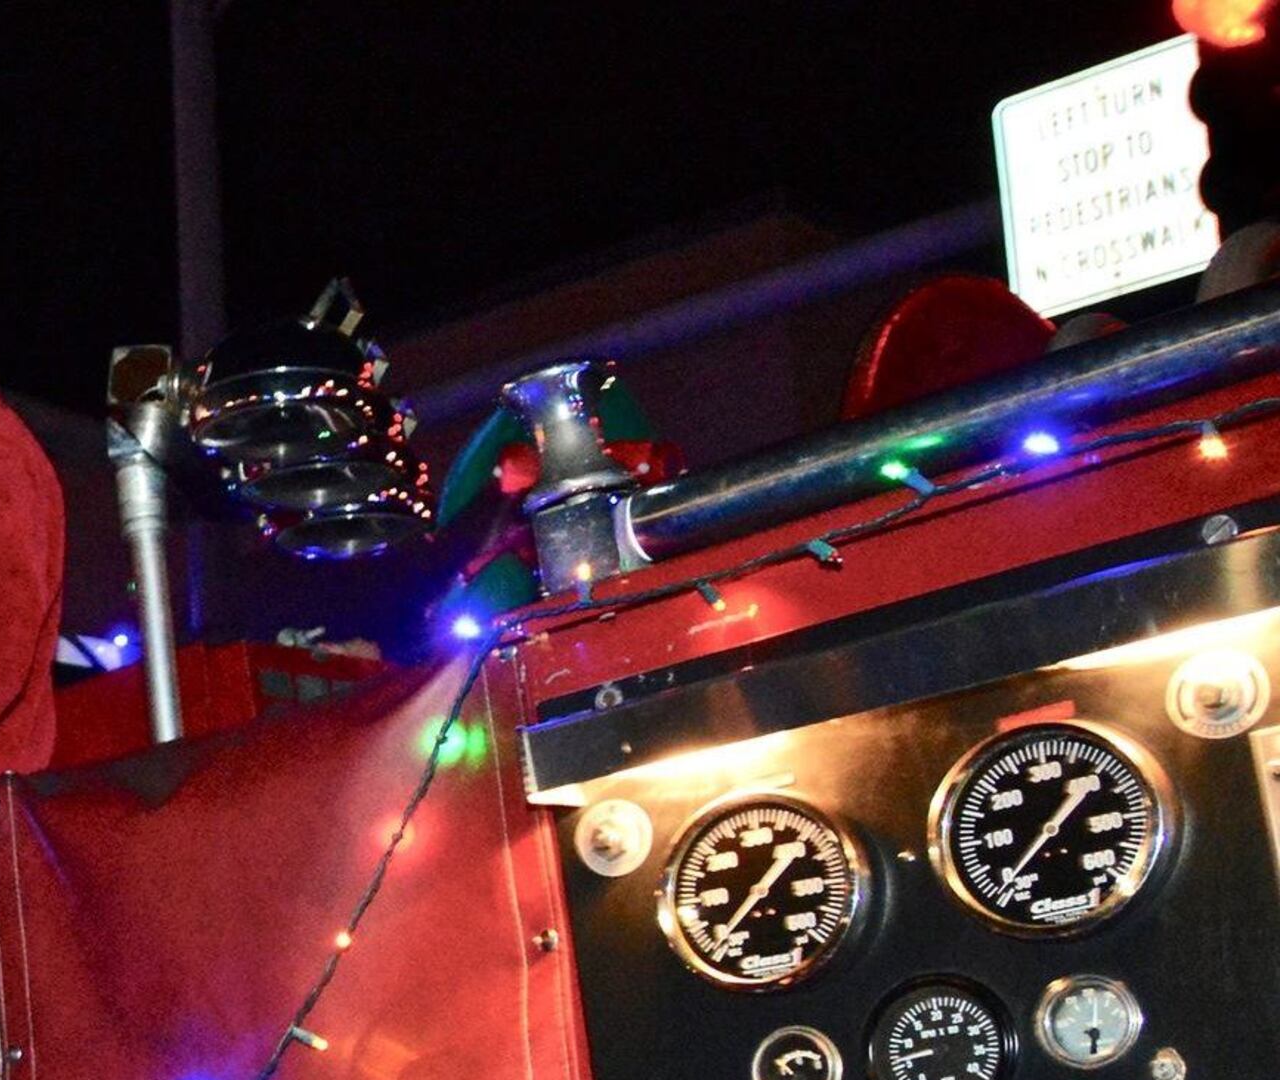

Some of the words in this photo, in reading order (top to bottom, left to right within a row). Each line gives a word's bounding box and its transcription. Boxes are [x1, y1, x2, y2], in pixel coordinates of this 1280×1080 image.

[1039, 100, 1088, 141] LEFT
[1097, 77, 1163, 119] TURN
[1058, 142, 1114, 184] STOP
[1127, 130, 1154, 158] TO
[1029, 167, 1195, 235] PEDESTRIANS
[991, 789, 1023, 811] 200
[984, 828, 1013, 848] 100
[930, 1010, 943, 1021] 20
[951, 1013, 964, 1024] 25
